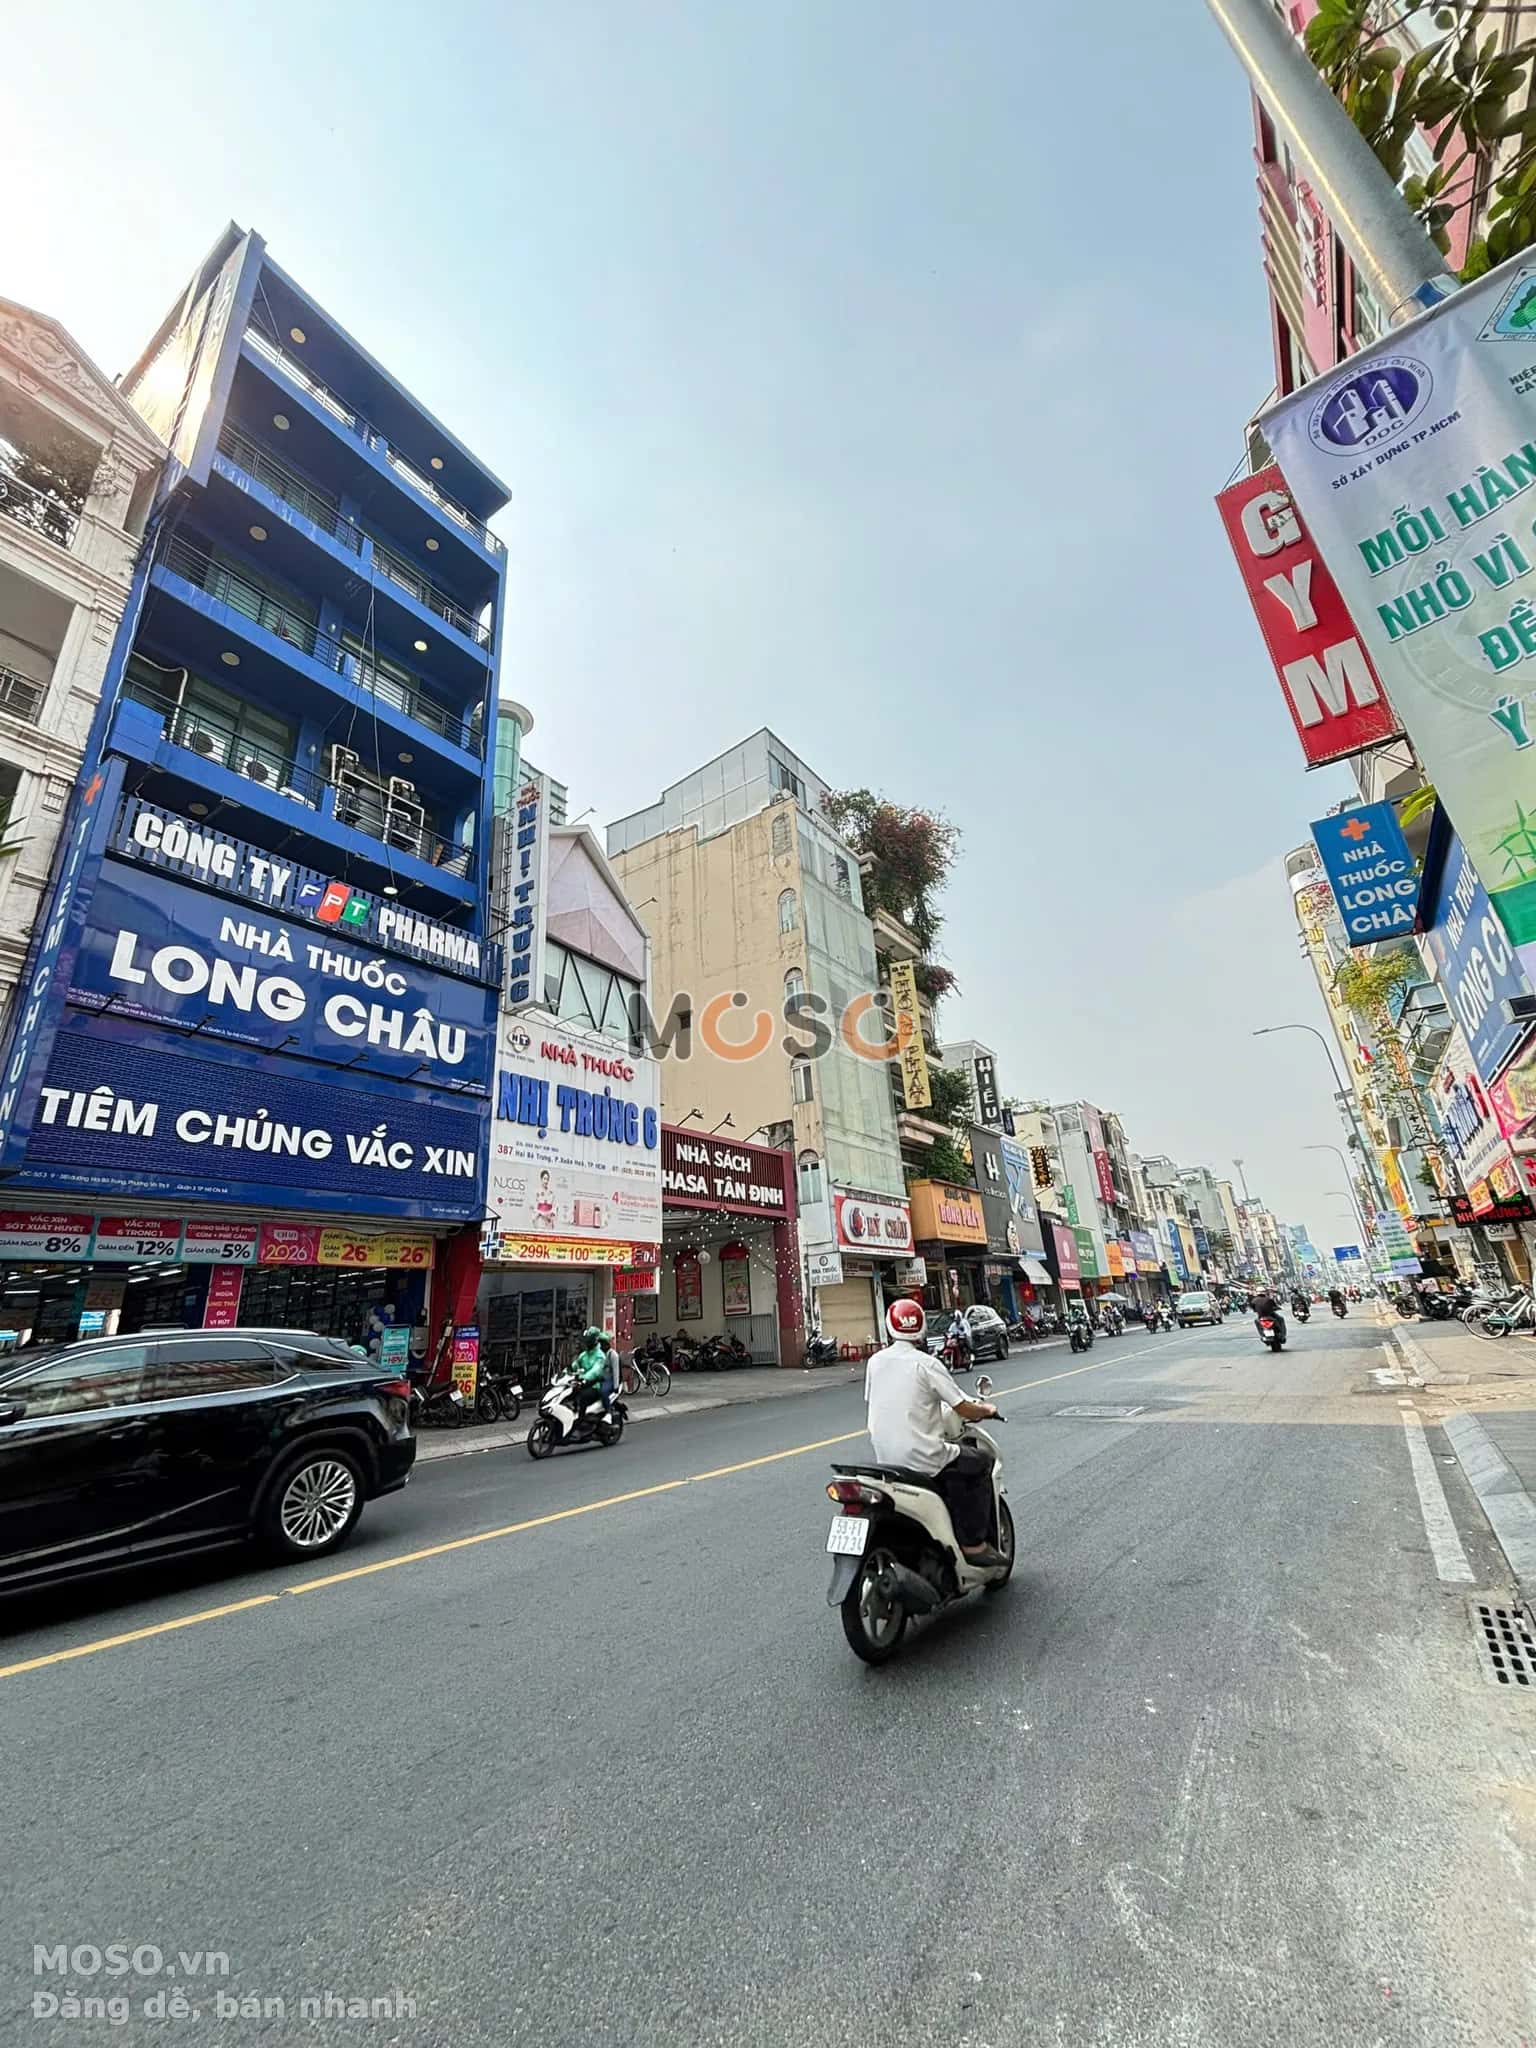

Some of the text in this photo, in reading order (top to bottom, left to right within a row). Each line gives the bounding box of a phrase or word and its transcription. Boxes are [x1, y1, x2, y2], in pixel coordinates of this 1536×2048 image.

[1331, 410, 1462, 489] SỞ XÂY DỰNG TP.HCM
[1364, 419, 1405, 447] DOC
[1357, 503, 1449, 576] MỖI
[1241, 493, 1382, 729] GYM
[1376, 532, 1532, 643] NHỎ VÌ
[1488, 696, 1534, 751] Ý
[1338, 858, 1406, 888] THUỐC
[1342, 840, 1387, 864] NHÀ
[134, 811, 481, 969] CÔNG TY FPT PHARMA
[1342, 879, 1417, 911] LONG
[1445, 895, 1466, 950] NHÀ
[219, 916, 408, 996] NHÀ THUỐC
[109, 928, 466, 1065] LONG CHÂU
[1455, 945, 1496, 1043] LONG
[540, 1040, 578, 1068] NHÀ
[580, 1052, 635, 1083] THUỐC
[39, 1085, 476, 1178] TIÊM CHỦNG VẮC XIN
[497, 1070, 658, 1150] NHỊ TRƯNG 6
[497, 1143, 514, 1157] 387
[676, 1143, 711, 1166] NHÀ
[713, 1150, 752, 1173] SÁCH
[713, 1176, 746, 1200] TÂN
[749, 1184, 784, 1207] ĐỊNH
[44, 1236, 81, 1254] 8%
[135, 1240, 175, 1257] 12%
[221, 1242, 251, 1260] 5%
[265, 1243, 308, 1262] 2026
